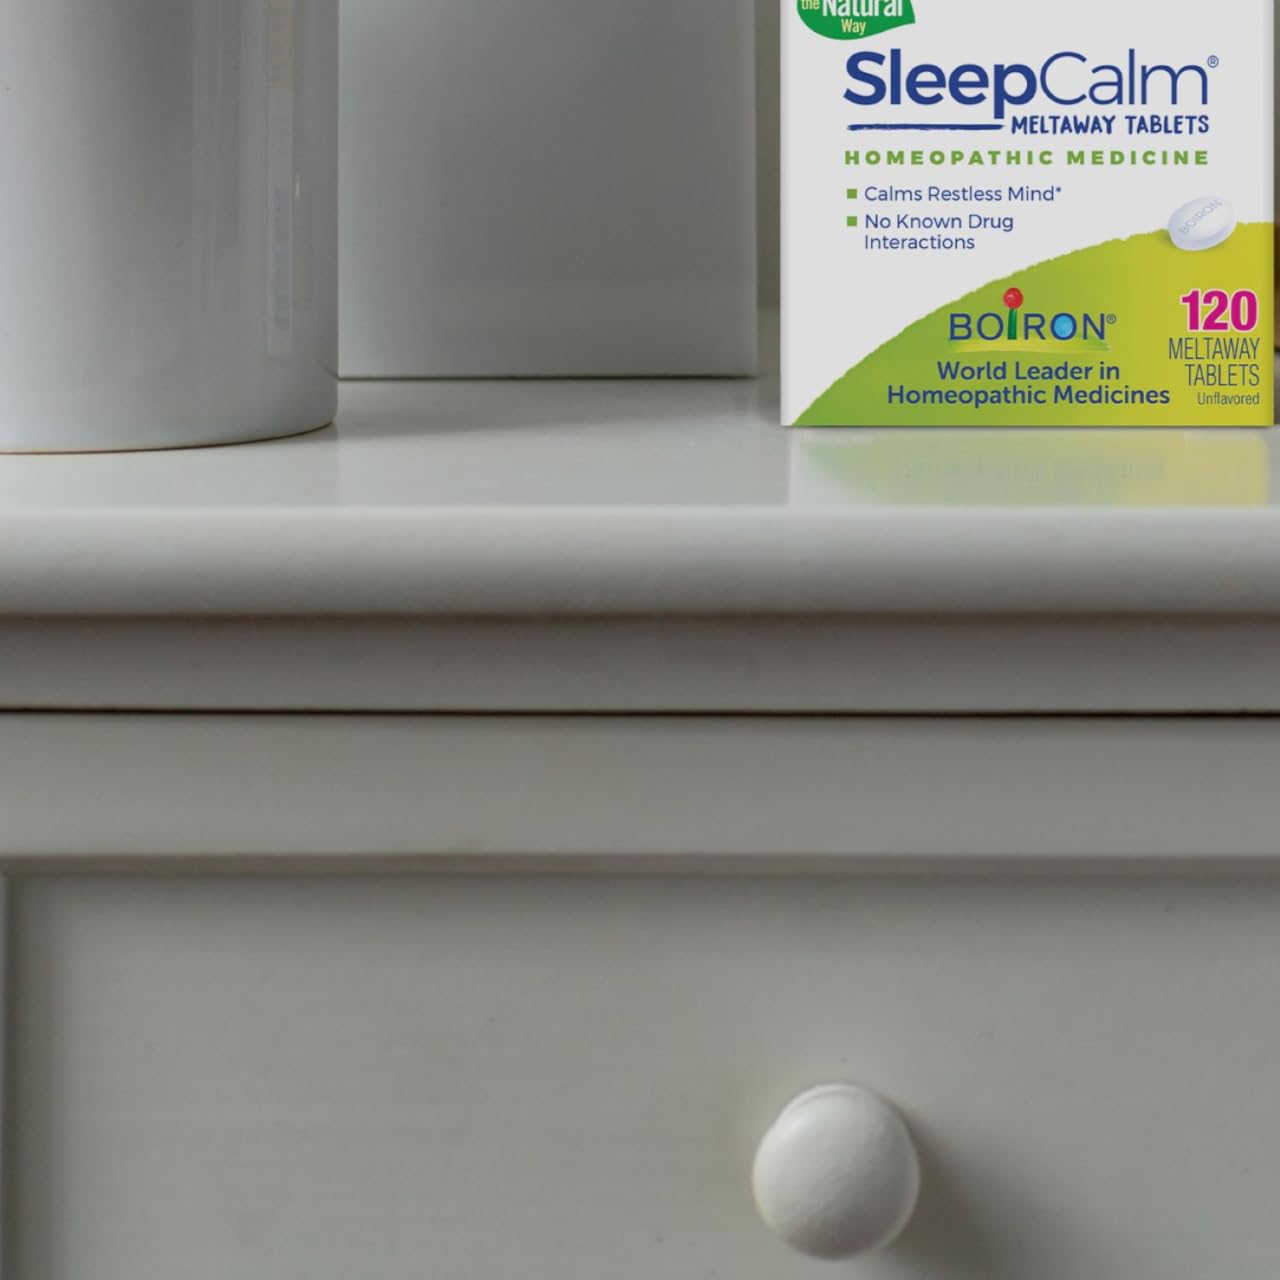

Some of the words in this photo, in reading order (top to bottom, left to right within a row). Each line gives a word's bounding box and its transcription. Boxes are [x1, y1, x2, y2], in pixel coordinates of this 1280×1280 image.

[841, 19, 866, 36] Way
[1012, 115, 1115, 135] MELTAWAY
[1126, 115, 1210, 134] TABLETS
[844, 150, 1054, 165] HOMEOPATHIC
[1067, 150, 1209, 165] MEDICINE
[864, 186, 923, 201] Calms
[928, 186, 1002, 201] Restless
[865, 214, 891, 230] No
[897, 214, 963, 230] Known
[968, 214, 1014, 233] Drug
[1177, 199, 1224, 234] BOIRON
[865, 234, 975, 250] Interactions
[1181, 289, 1258, 333] 120
[1169, 337, 1260, 360] MELTAWAY
[937, 361, 1006, 381] World
[1015, 361, 1093, 381] Leader
[1099, 361, 1120, 381] in
[1185, 364, 1260, 387] TABLETS
[887, 386, 1046, 410] Homeopathic
[1053, 386, 1170, 405] Medicines
[1197, 392, 1260, 406] Unflavored
